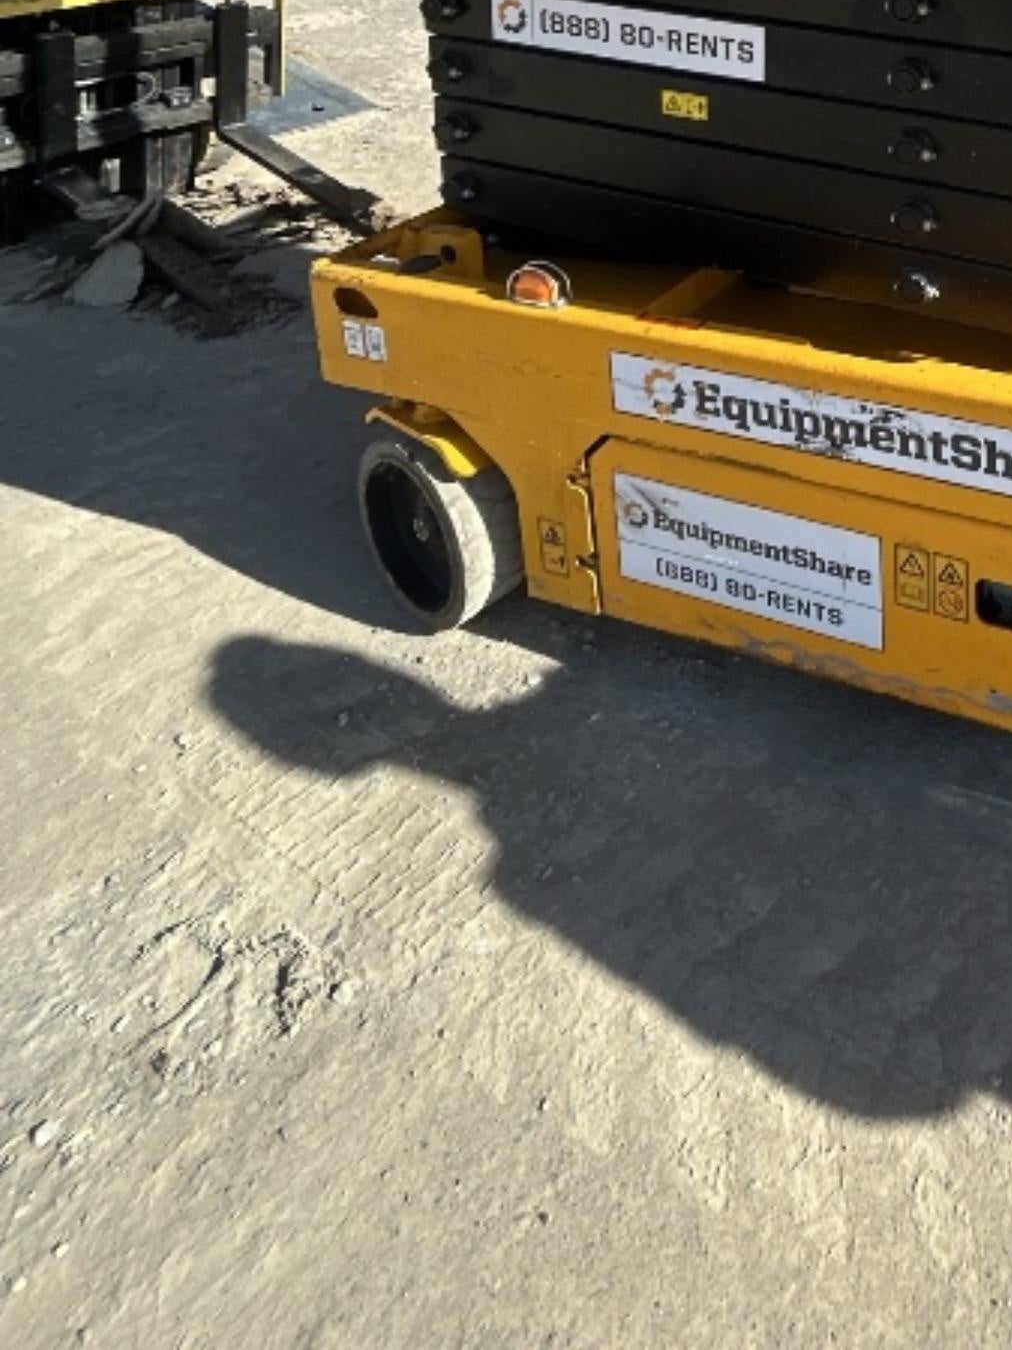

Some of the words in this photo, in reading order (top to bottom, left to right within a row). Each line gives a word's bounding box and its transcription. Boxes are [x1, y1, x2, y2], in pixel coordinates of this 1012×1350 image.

[539, 8, 610, 42] (888)
[620, 23, 755, 64] 80-RENTS
[652, 508, 872, 587] EquipmentShare
